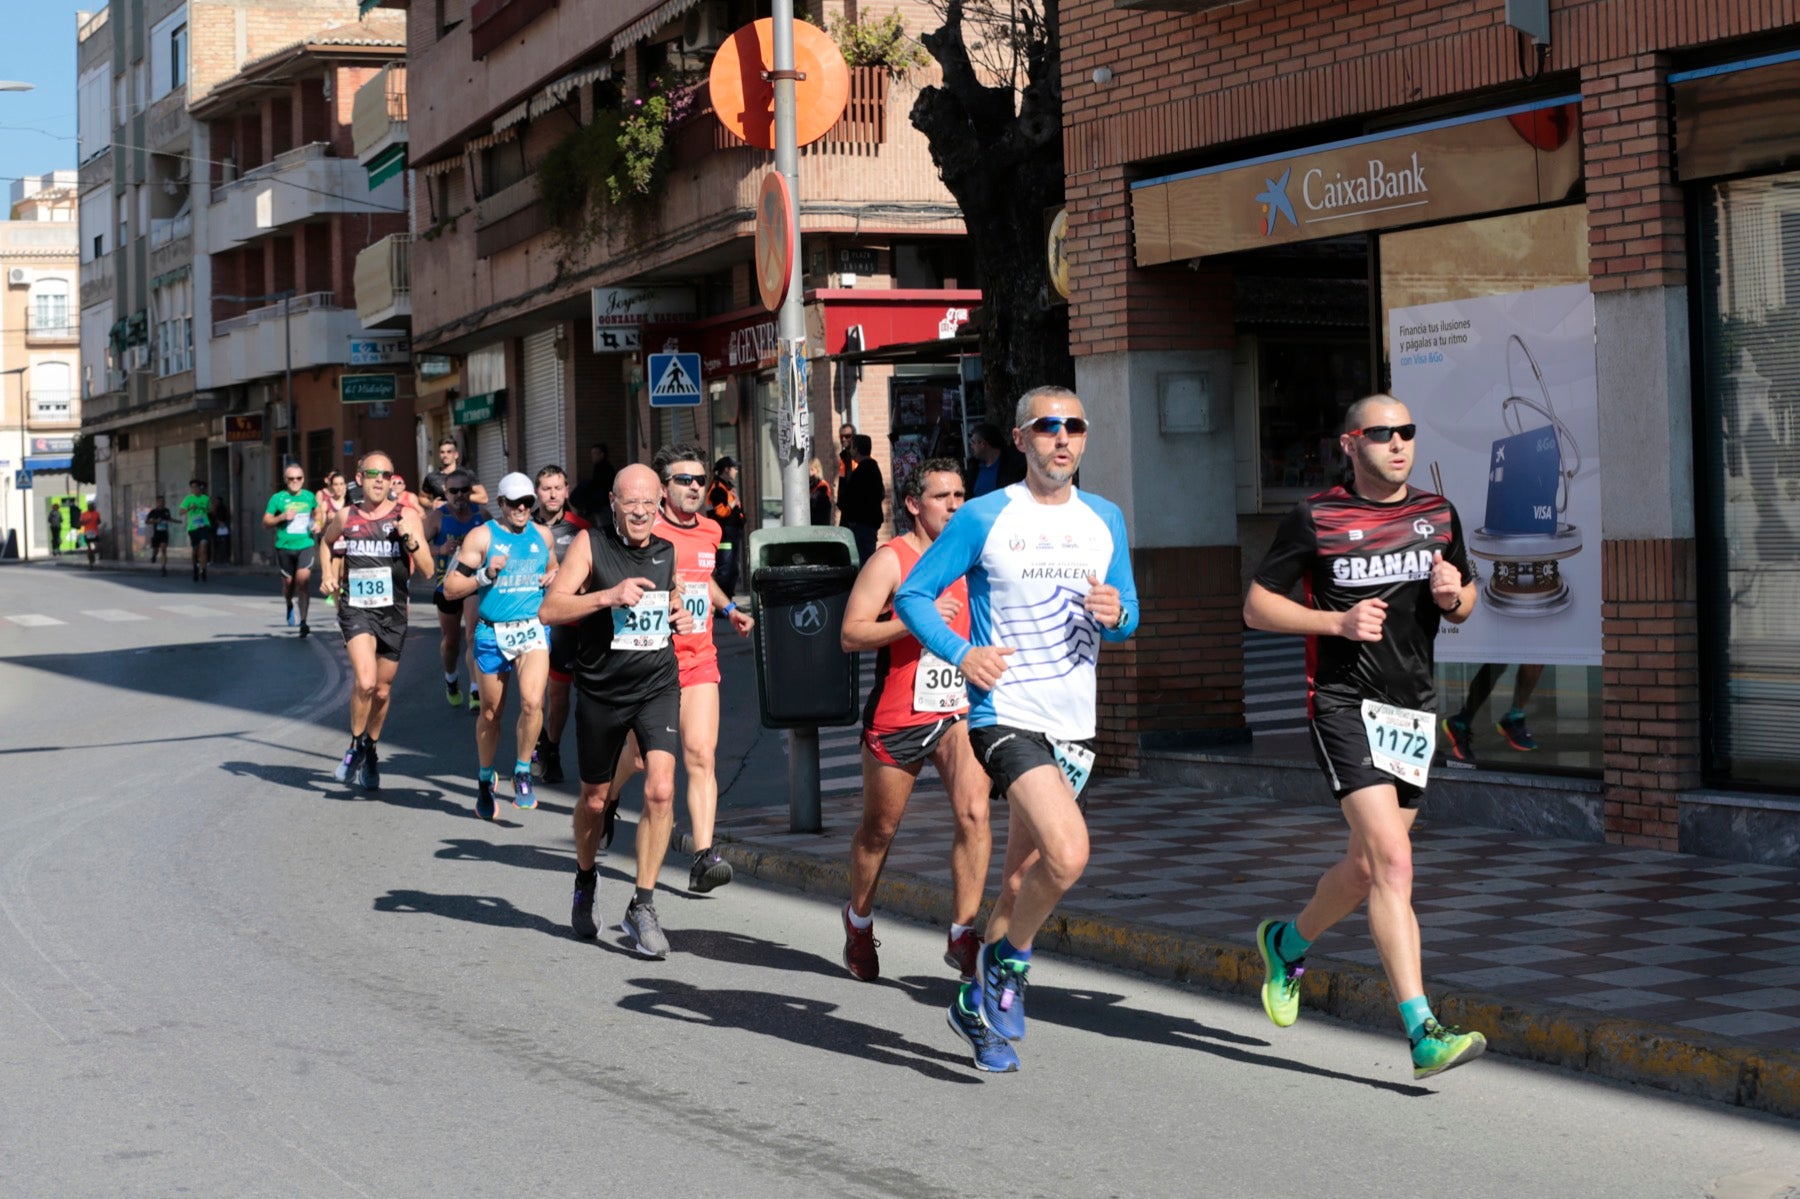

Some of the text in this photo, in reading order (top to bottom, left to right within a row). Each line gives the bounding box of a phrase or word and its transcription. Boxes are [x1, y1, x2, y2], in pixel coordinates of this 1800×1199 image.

[1302, 151, 1428, 211] CaixaBank
[1399, 319, 1471, 337] Financia tus ilusiones
[1400, 342, 1406, 353] y
[1439, 335, 1447, 346] tu
[1448, 334, 1468, 345] ritmo
[1533, 505, 1552, 520] VISA
[1021, 567, 1097, 579] MARACENA
[1332, 549, 1436, 580] GRANAD
[356, 580, 385, 595] 138
[624, 609, 664, 632] 467
[1447, 625, 1459, 634] vida
[926, 668, 965, 689] 305
[1376, 725, 1427, 760] 1172
